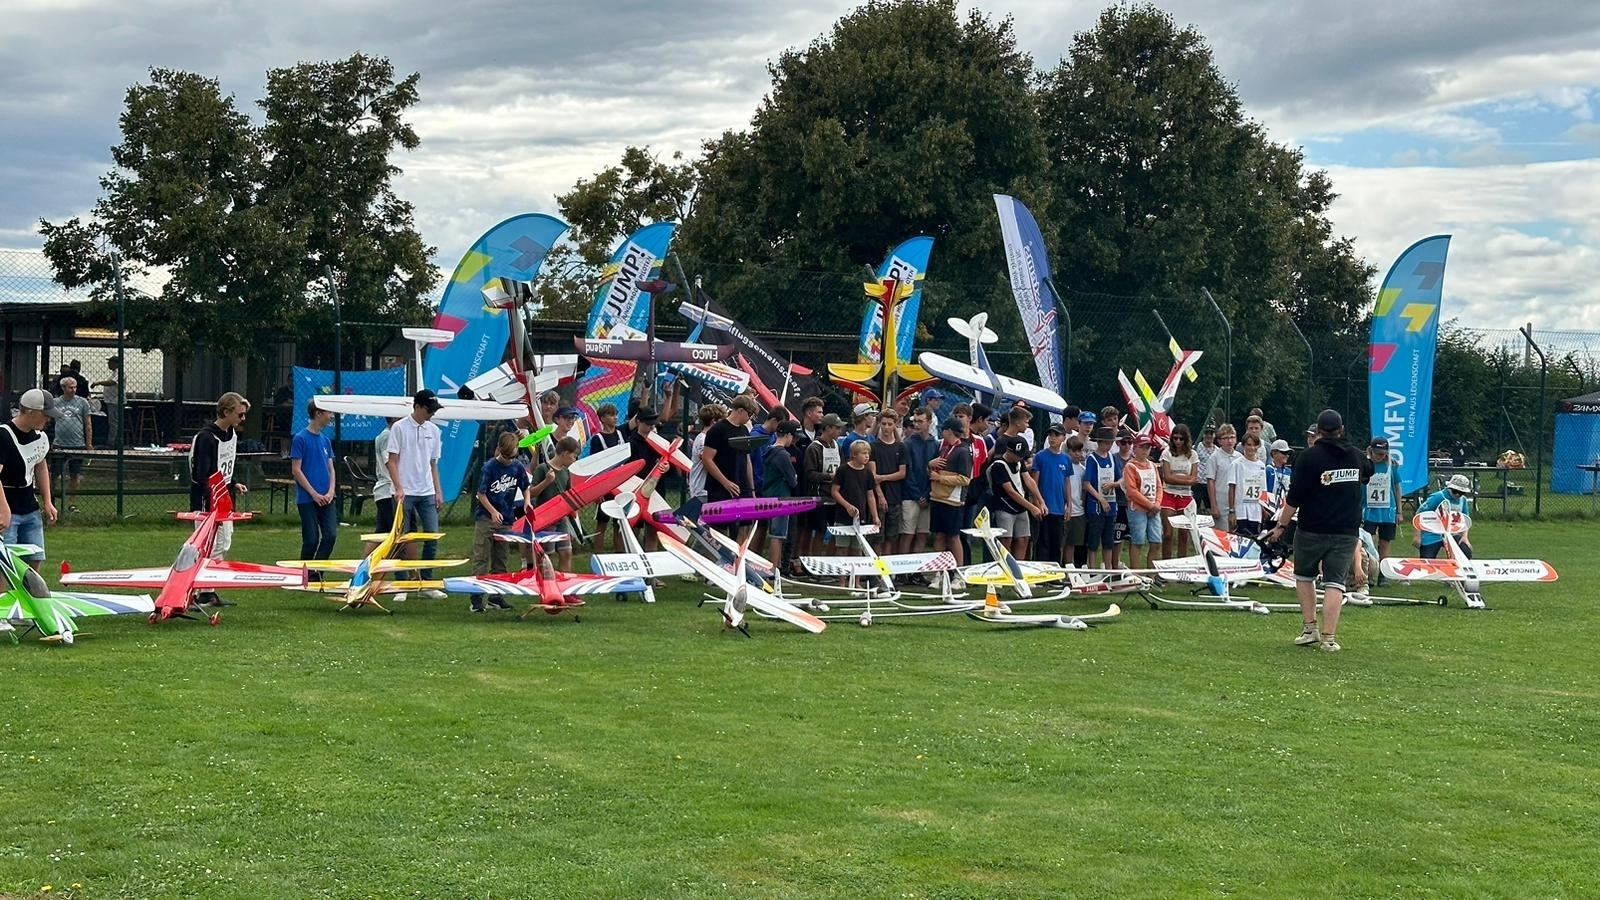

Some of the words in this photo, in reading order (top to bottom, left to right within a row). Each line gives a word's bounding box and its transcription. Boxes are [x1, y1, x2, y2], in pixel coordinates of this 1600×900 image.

[607, 246, 646, 316] JUMP!
[585, 343, 611, 355] Jugend
[692, 349, 718, 360] FMCO
[1411, 349, 1420, 396] LEIDENSCHAFT
[1384, 390, 1406, 465] DMFV
[1408, 412, 1416, 438] FLIEGEN
[221, 460, 232, 476] 28
[1335, 470, 1358, 478] JUMP
[1246, 486, 1260, 498] 43
[1371, 489, 1385, 501] 41
[604, 561, 639, 572] D-EFUN
